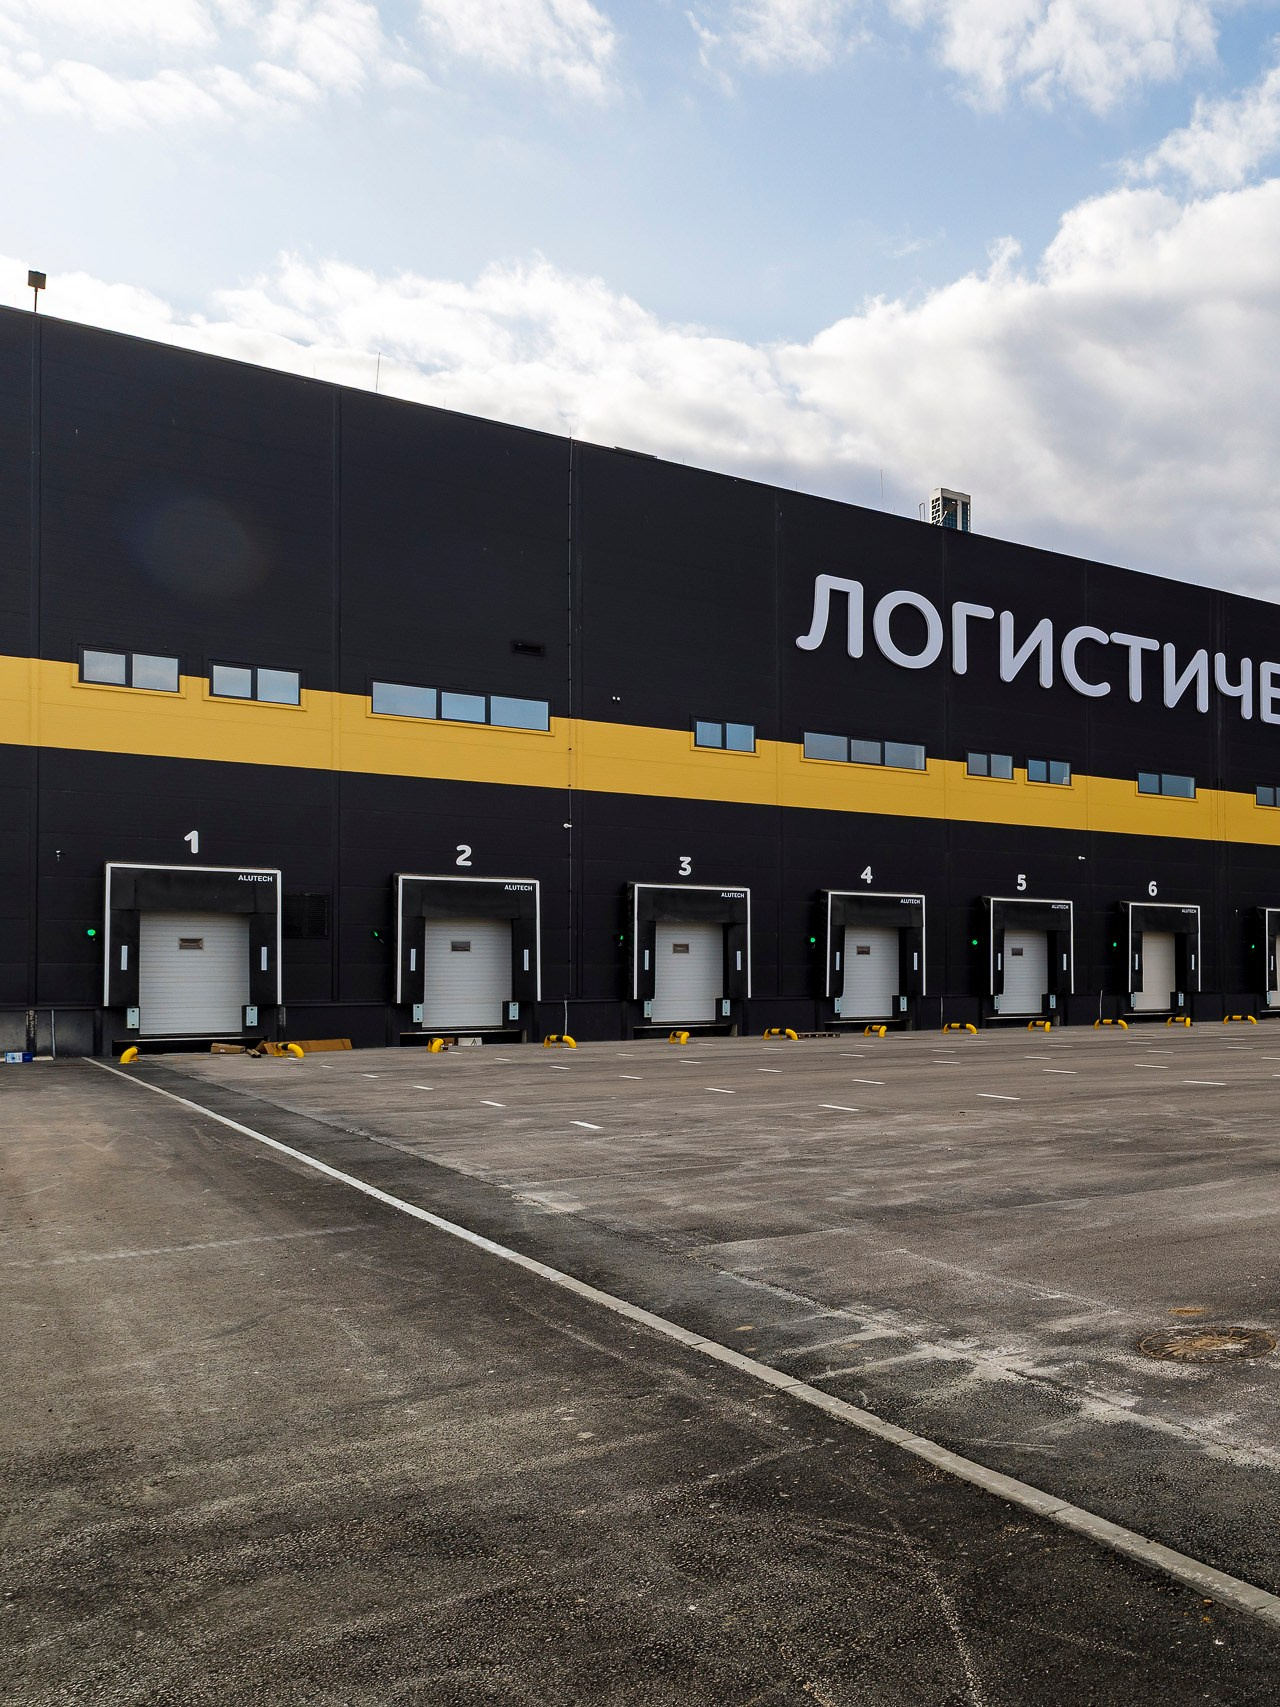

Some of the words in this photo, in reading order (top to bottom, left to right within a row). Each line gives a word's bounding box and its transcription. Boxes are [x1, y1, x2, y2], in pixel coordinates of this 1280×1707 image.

[184, 831, 199, 854] 1
[456, 845, 472, 866] 2
[679, 857, 692, 876] 3
[861, 866, 873, 884] 4
[238, 875, 273, 883] ALUTECH
[1016, 874, 1027, 891] 5
[504, 884, 533, 892] ALUTECH
[1148, 881, 1158, 896] 6
